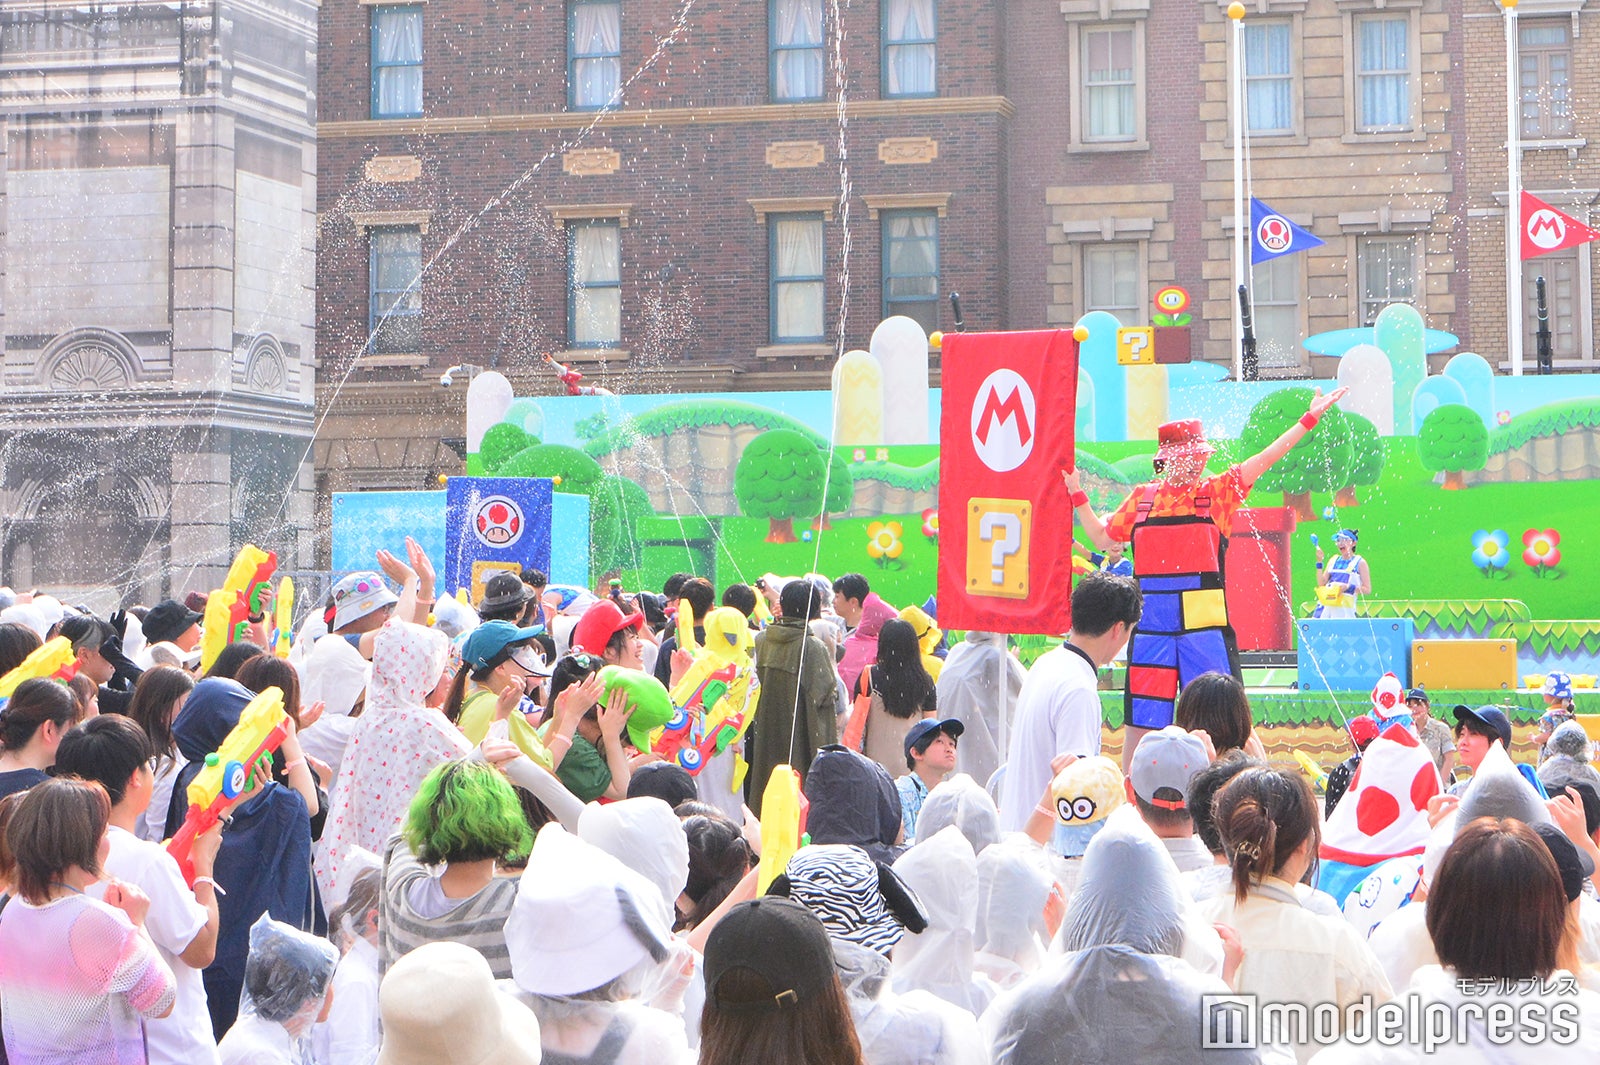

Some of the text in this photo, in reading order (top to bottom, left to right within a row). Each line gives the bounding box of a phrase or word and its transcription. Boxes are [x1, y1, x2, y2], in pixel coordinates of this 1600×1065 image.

[1530, 215, 1562, 240] M
[975, 384, 1032, 448] M
[979, 511, 1022, 586] ?
